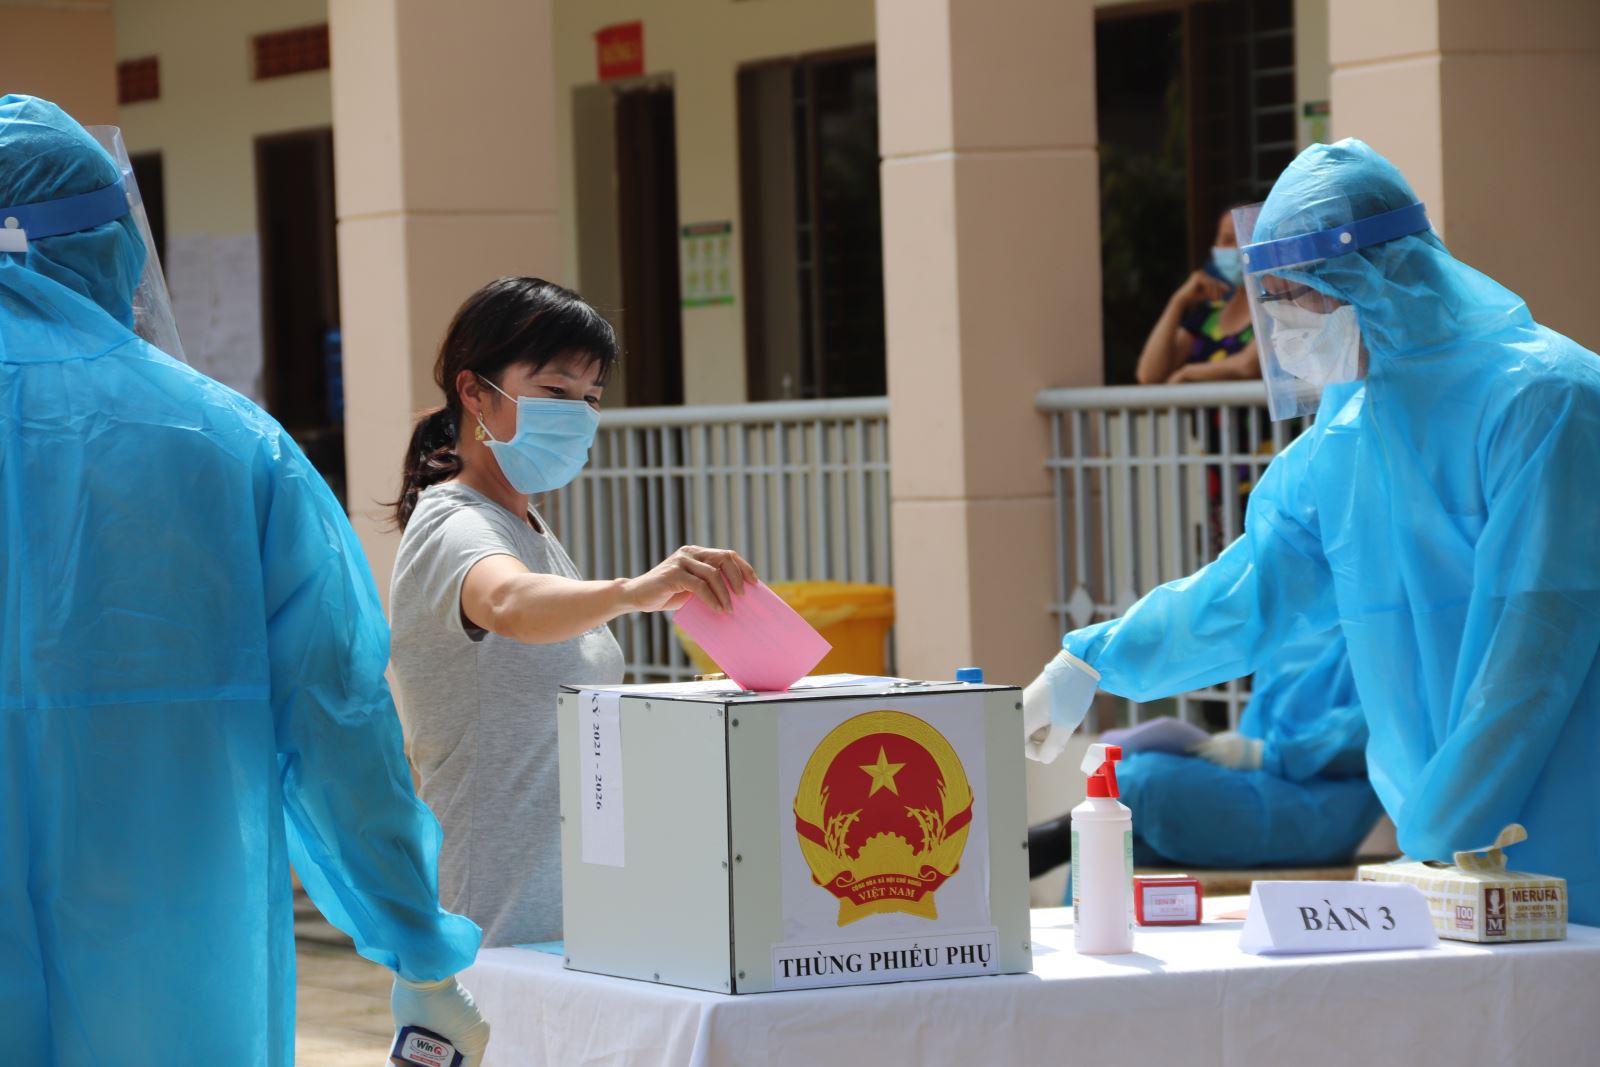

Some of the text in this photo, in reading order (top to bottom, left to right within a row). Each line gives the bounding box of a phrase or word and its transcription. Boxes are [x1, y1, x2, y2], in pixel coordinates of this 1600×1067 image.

[593, 723, 601, 757] 2021
[595, 774, 603, 811] 2026
[858, 886, 917, 900] VIỆT NAM
[1512, 889, 1559, 903] MERUFA
[1296, 899, 1396, 931] BÀN 3
[1456, 906, 1473, 920] 100
[1487, 918, 1505, 931] M
[779, 943, 992, 978] THÙNG PHIẾU PHỤ
